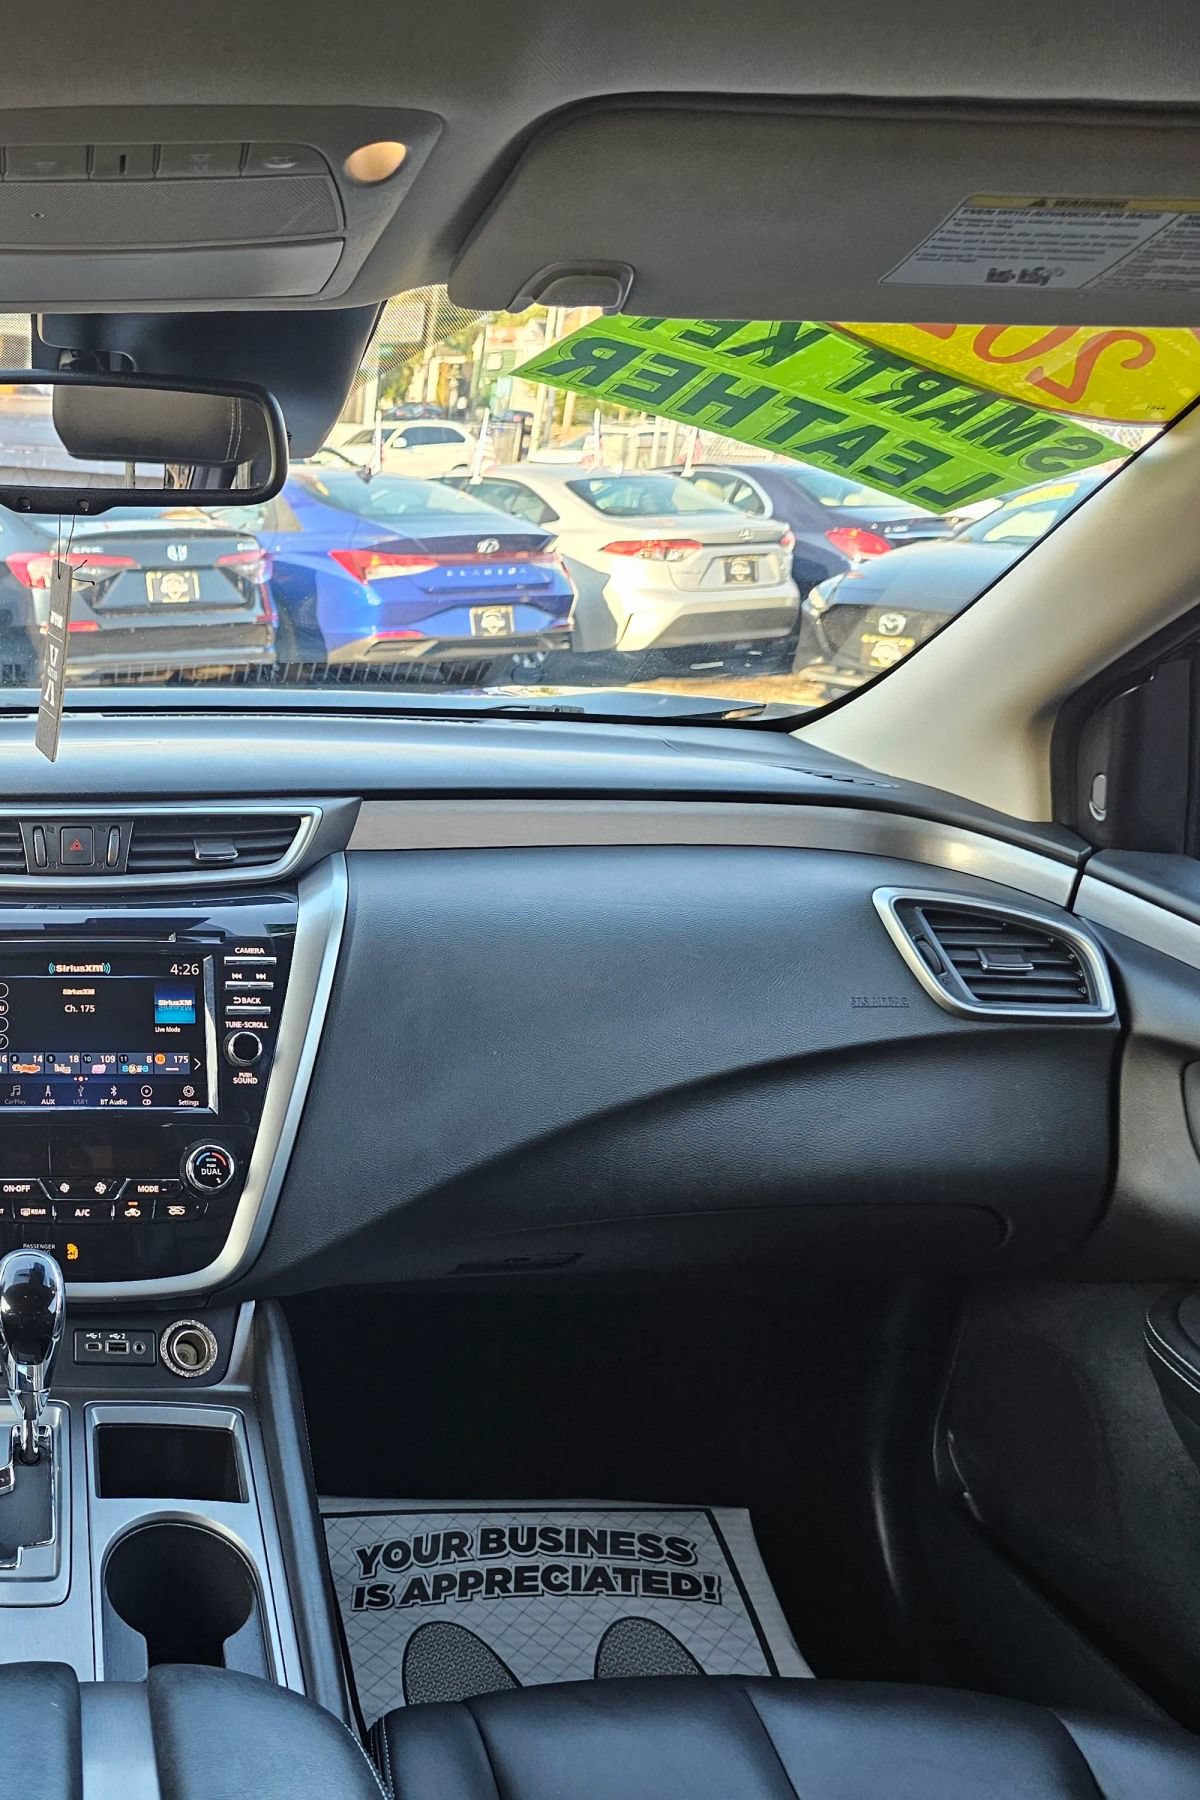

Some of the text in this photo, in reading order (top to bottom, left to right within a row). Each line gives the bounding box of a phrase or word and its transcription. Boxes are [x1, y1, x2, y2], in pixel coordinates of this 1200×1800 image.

[234, 947, 266, 955] CAMERA
[169, 963, 200, 976] 4:26
[64, 1004, 96, 1013] Ch. 175
[32, 1054, 44, 1063] 14
[68, 1054, 80, 1063] 18
[100, 1055, 116, 1063] 109
[146, 1055, 153, 1063] 8
[173, 1055, 189, 1064] 175
[232, 1077, 258, 1085] SOUND
[109, 1098, 128, 1106] Audio
[178, 1098, 200, 1107] Settings
[201, 1168, 222, 1176] DUAL
[137, 1185, 160, 1193] MODE
[74, 1208, 91, 1217] A/C
[355, 1526, 697, 1578] YOUR BUSINESS
[352, 1565, 723, 1611] IS APPRECIATED!
